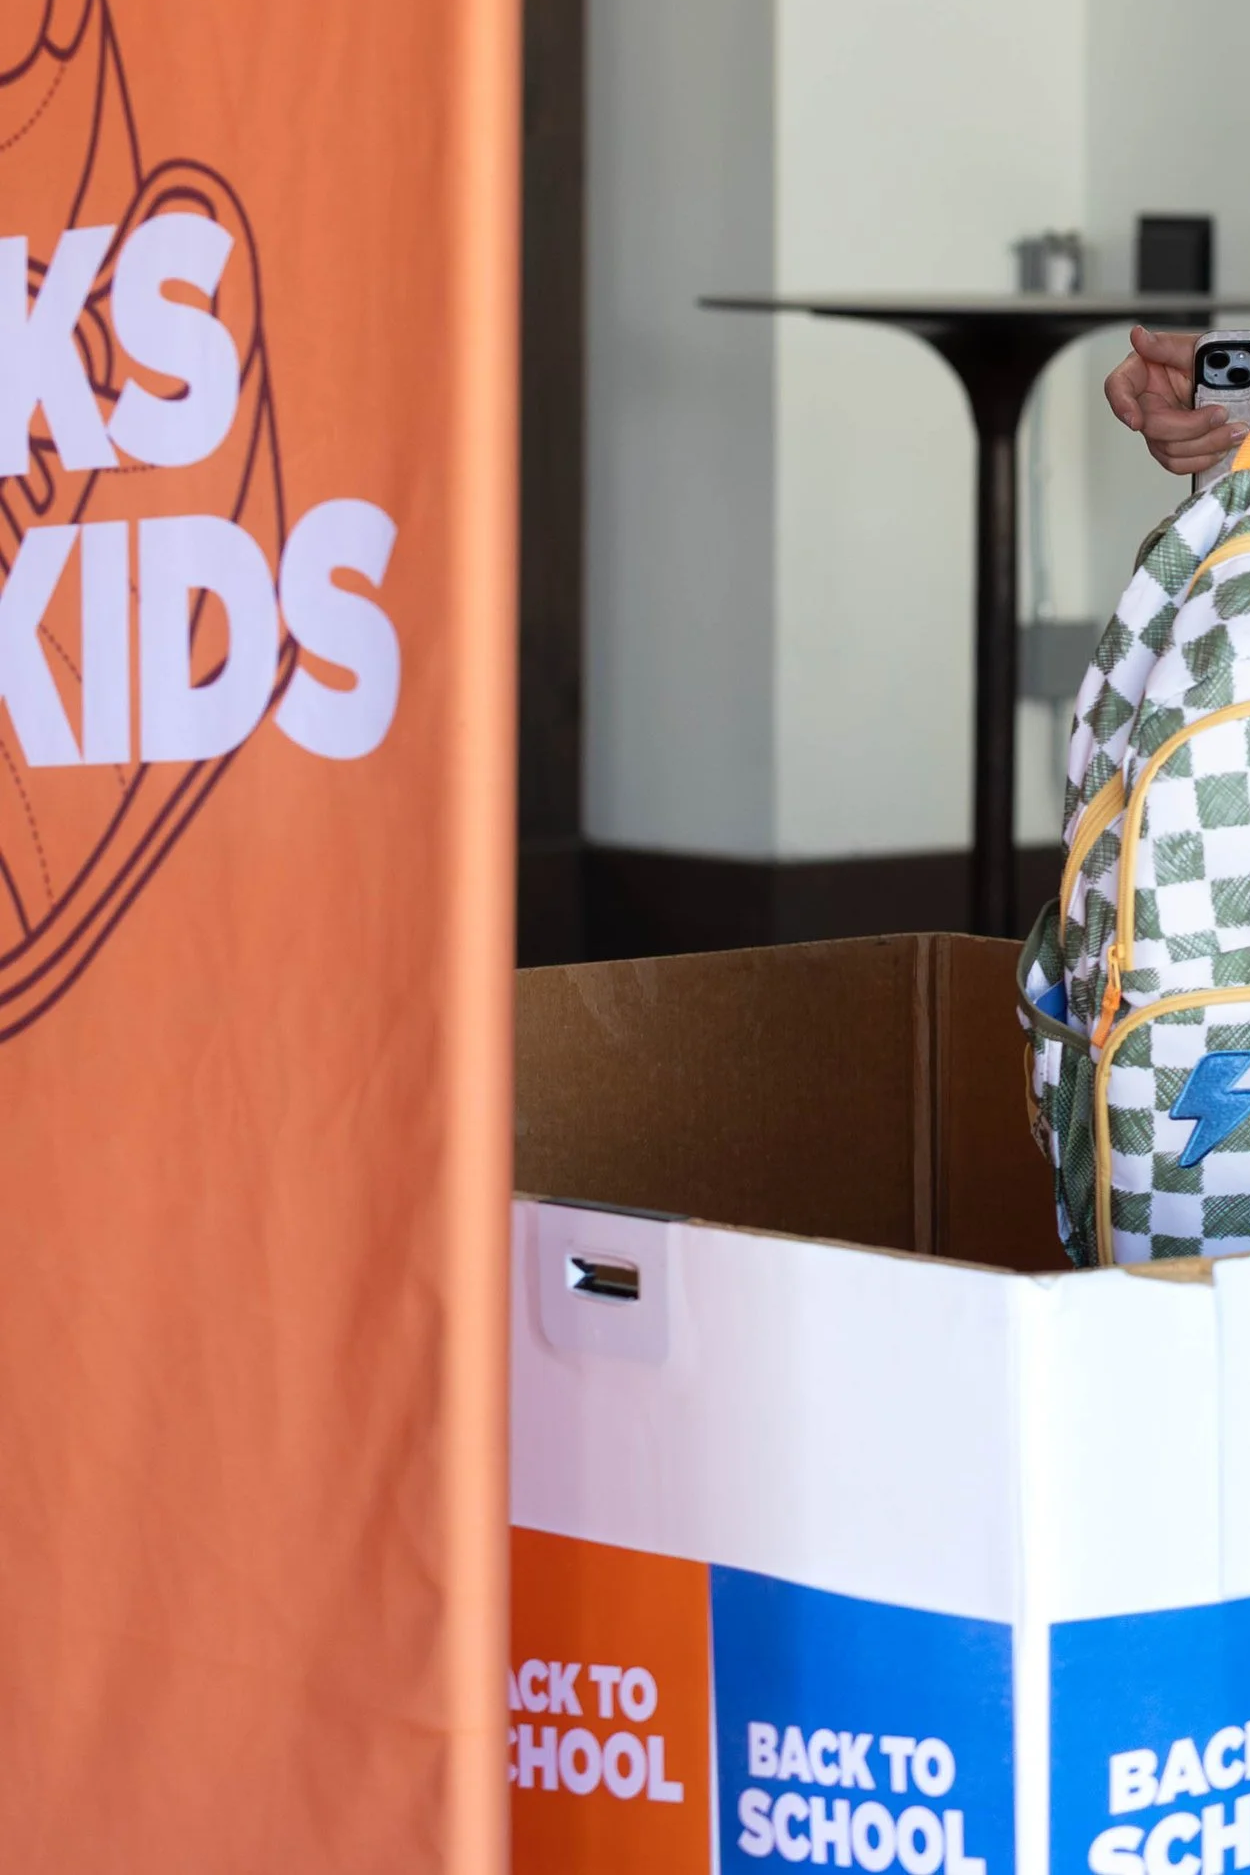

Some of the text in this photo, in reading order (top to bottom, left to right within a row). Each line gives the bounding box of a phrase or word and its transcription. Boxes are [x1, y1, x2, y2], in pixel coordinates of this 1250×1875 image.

[588, 1665, 658, 1722] TO
[508, 1724, 684, 1803] HOOL
[748, 1722, 957, 1798] BACK TO
[737, 1788, 987, 1875] SCHOOL
